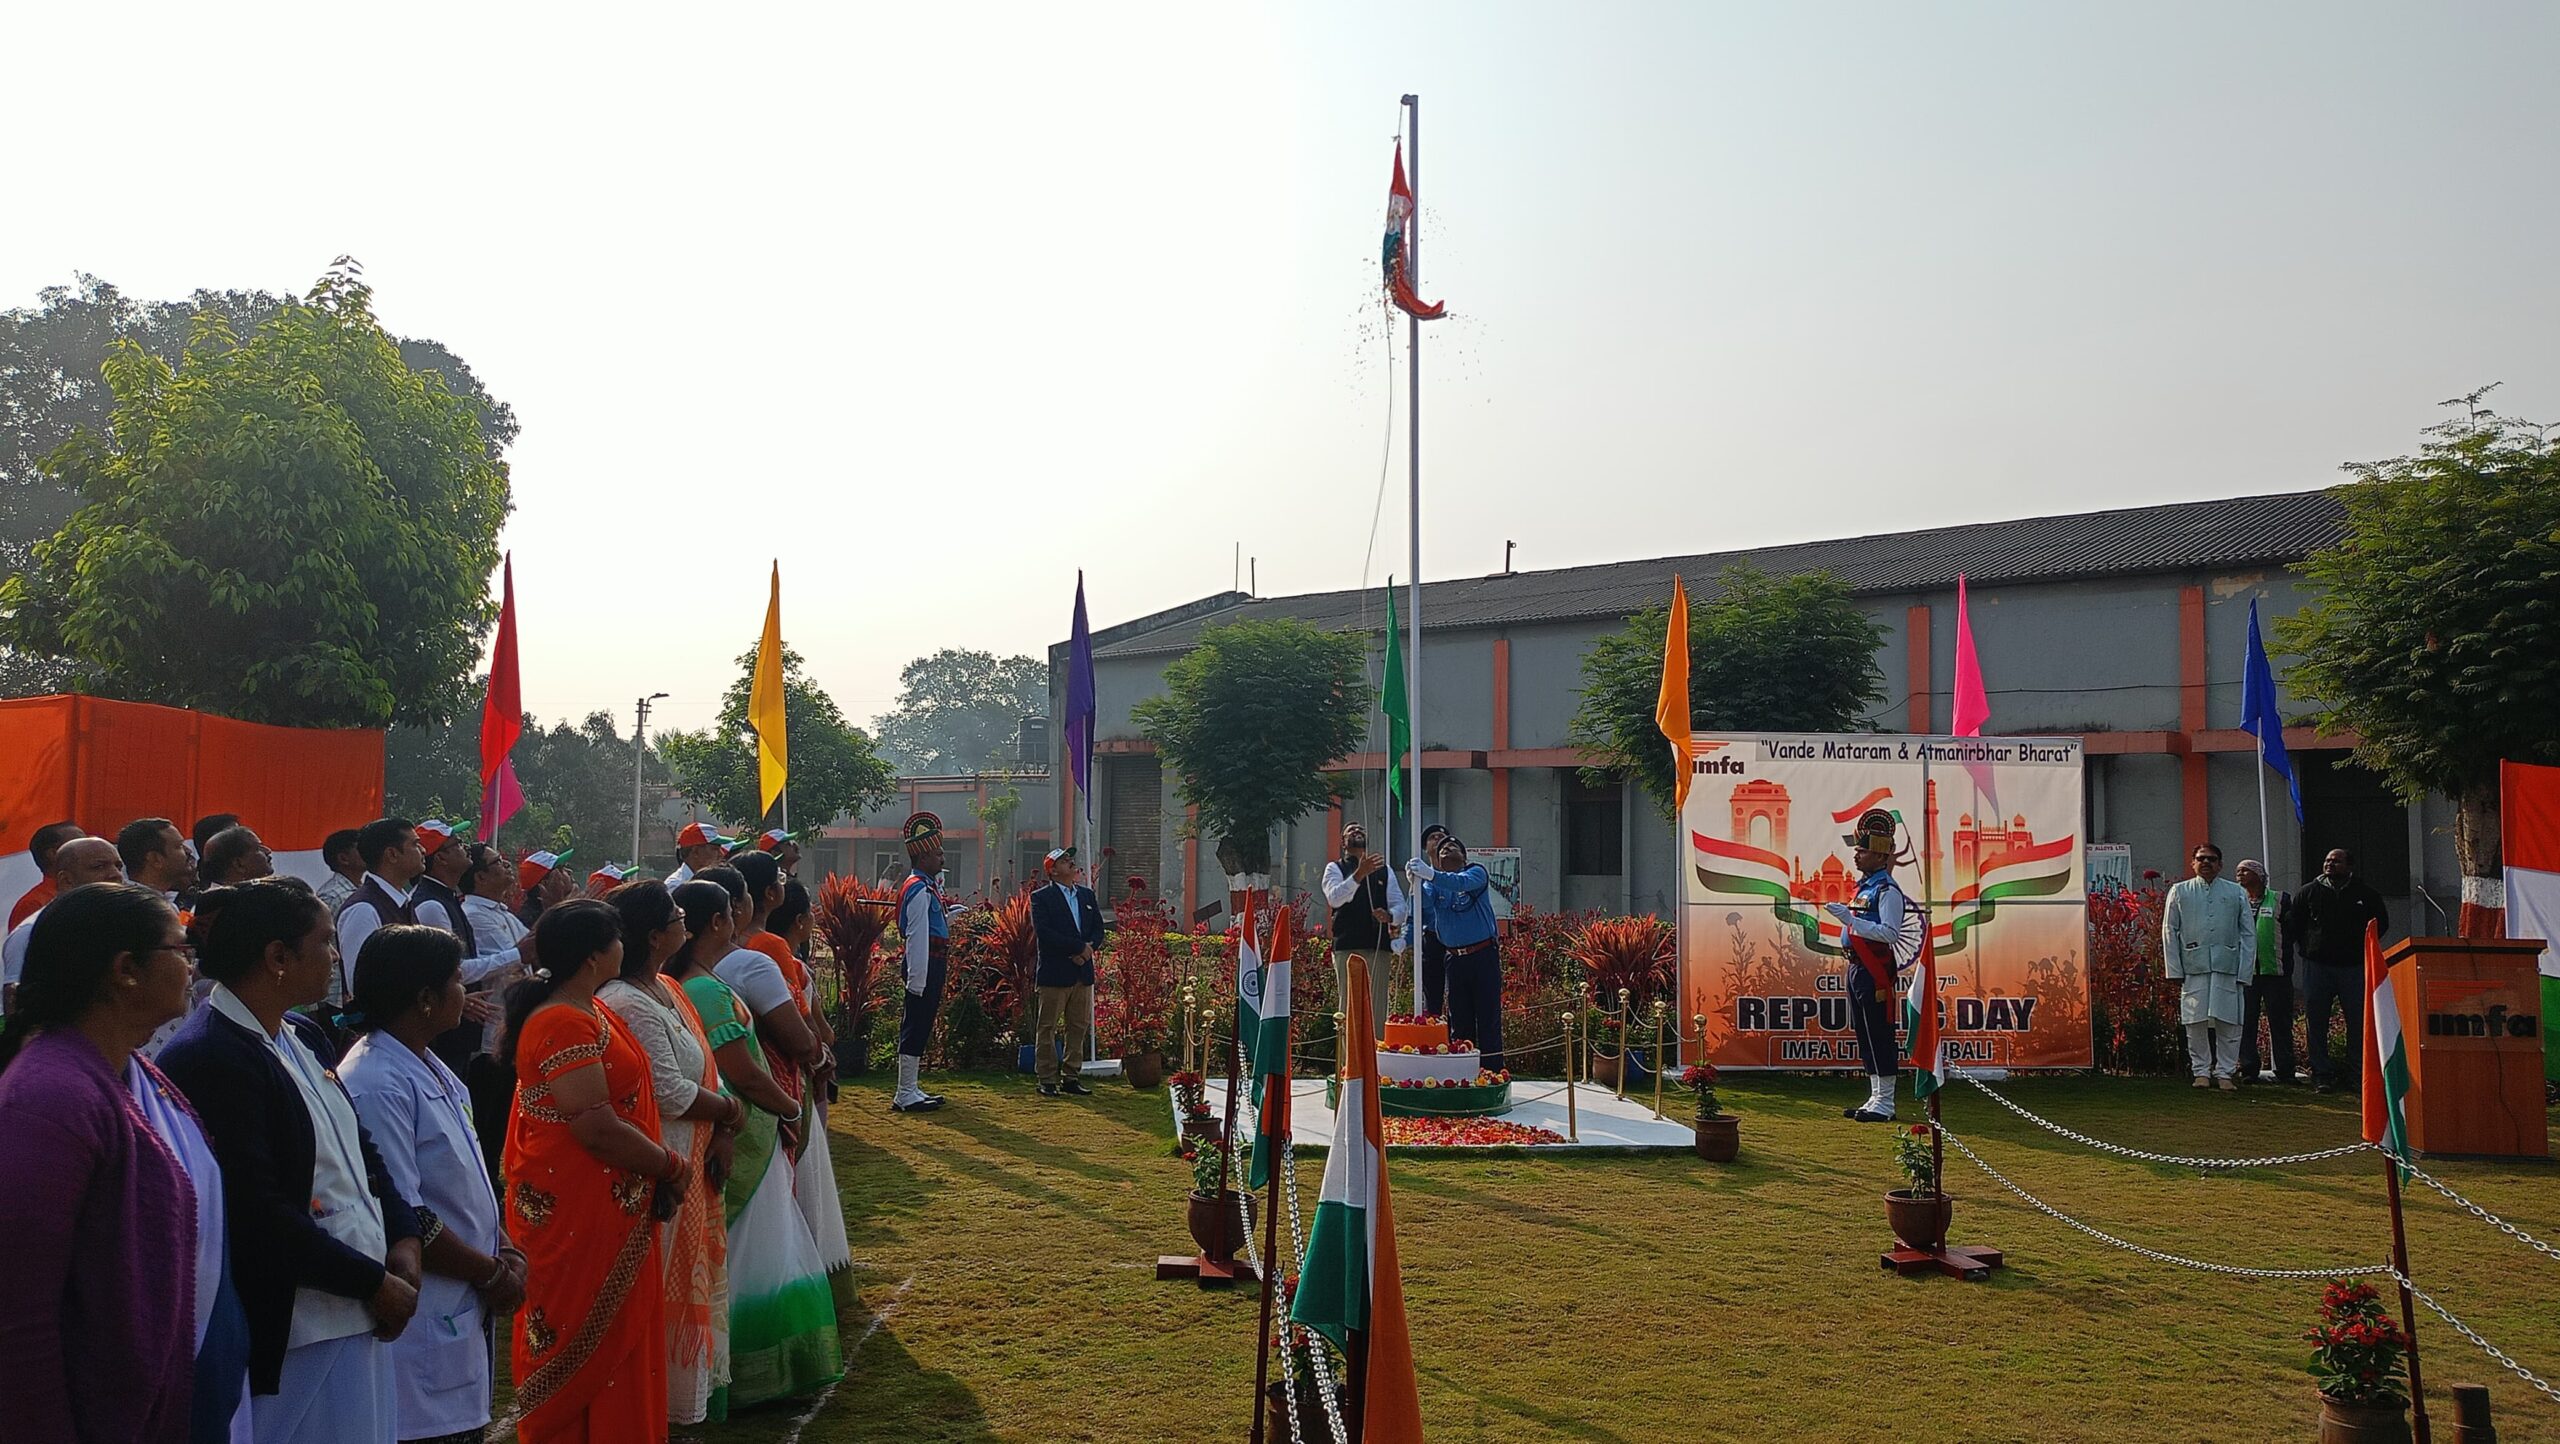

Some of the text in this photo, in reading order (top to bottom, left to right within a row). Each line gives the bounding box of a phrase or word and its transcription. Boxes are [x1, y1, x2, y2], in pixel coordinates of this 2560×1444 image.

[1822, 741, 1892, 761] Mataram
[1899, 742, 1909, 760] &
[1916, 743, 2012, 762] Atmanirbhar
[1956, 998, 2037, 1032] DAY
[1781, 1040, 1834, 1061] IMFA
